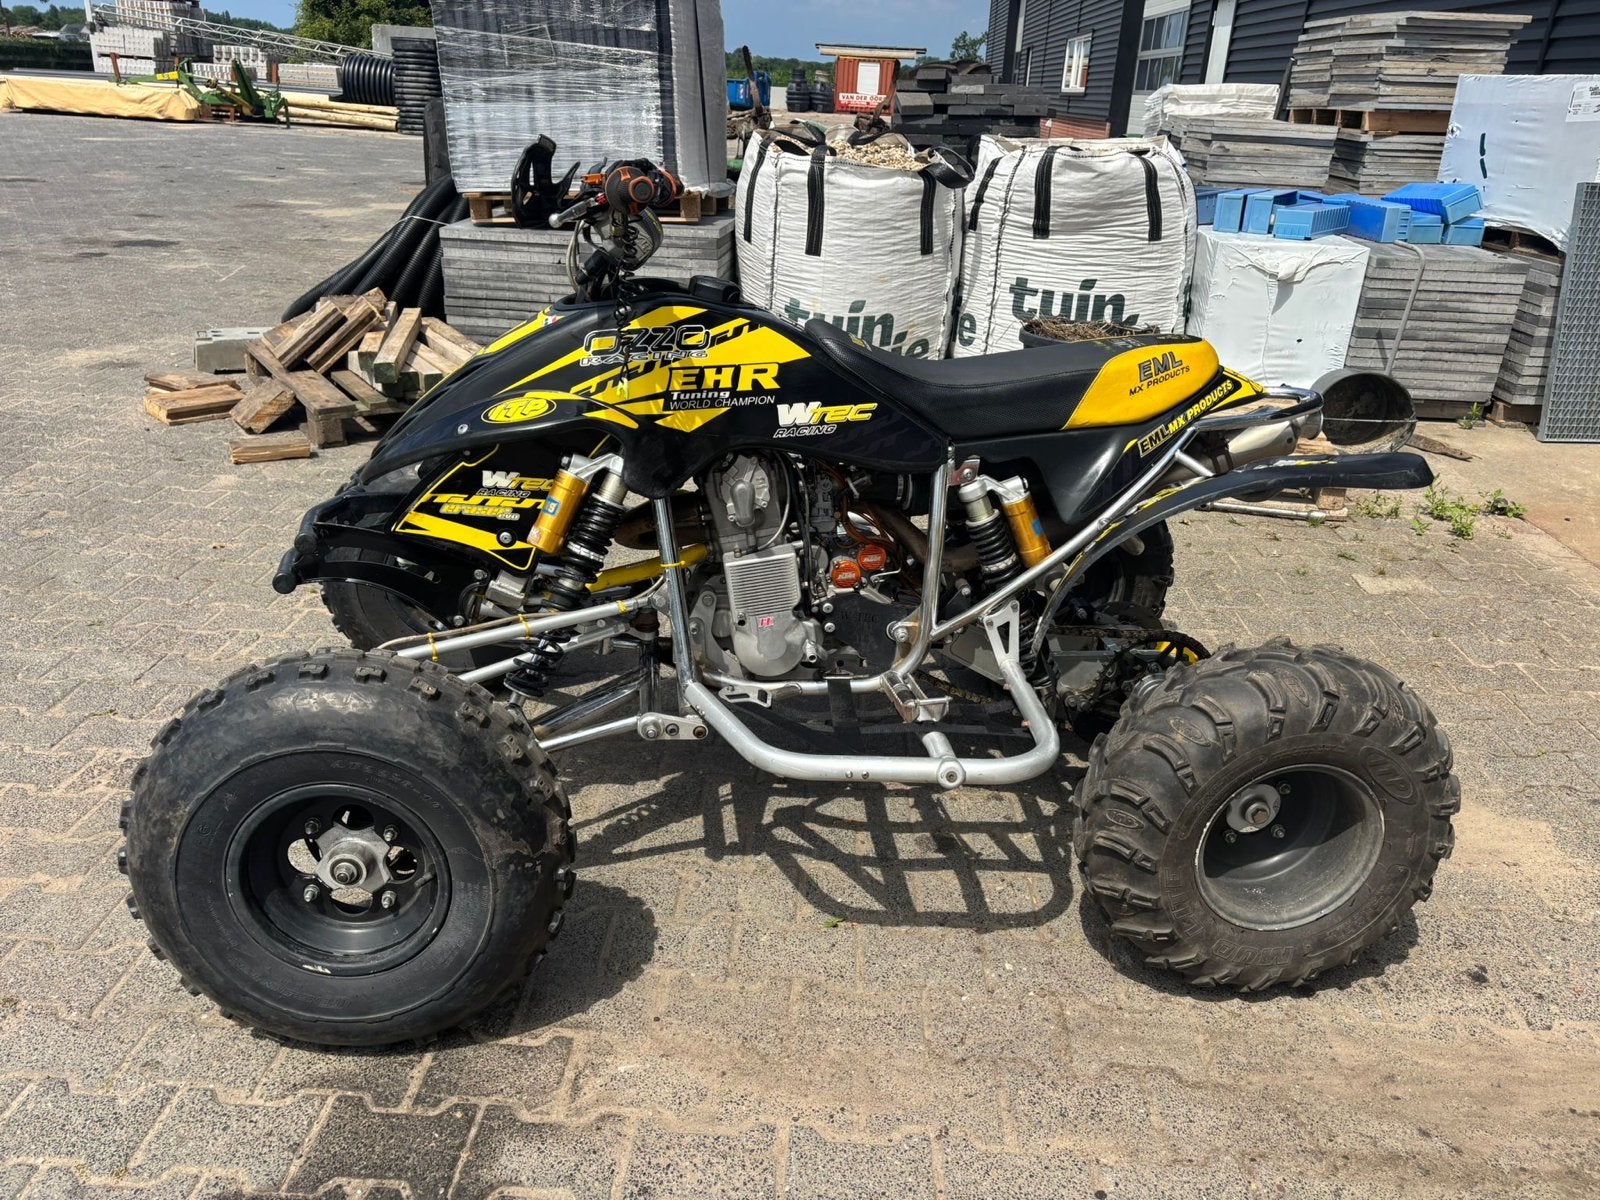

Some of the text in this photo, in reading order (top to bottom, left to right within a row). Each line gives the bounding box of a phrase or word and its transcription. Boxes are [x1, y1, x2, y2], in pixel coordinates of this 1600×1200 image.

[1009, 276, 1127, 326] tuin
[784, 297, 894, 347] tin
[580, 350, 708, 367] RACING
[1138, 351, 1183, 383] EML
[668, 362, 781, 391] EHR
[1129, 365, 1191, 397] MX PRODUCTS
[669, 395, 776, 410] WORLD CHAMPION
[670, 390, 731, 401] Tuning
[773, 424, 837, 438] RACING
[1138, 379, 1234, 456] EML MX PRODUCTS
[475, 488, 532, 499] RACING
